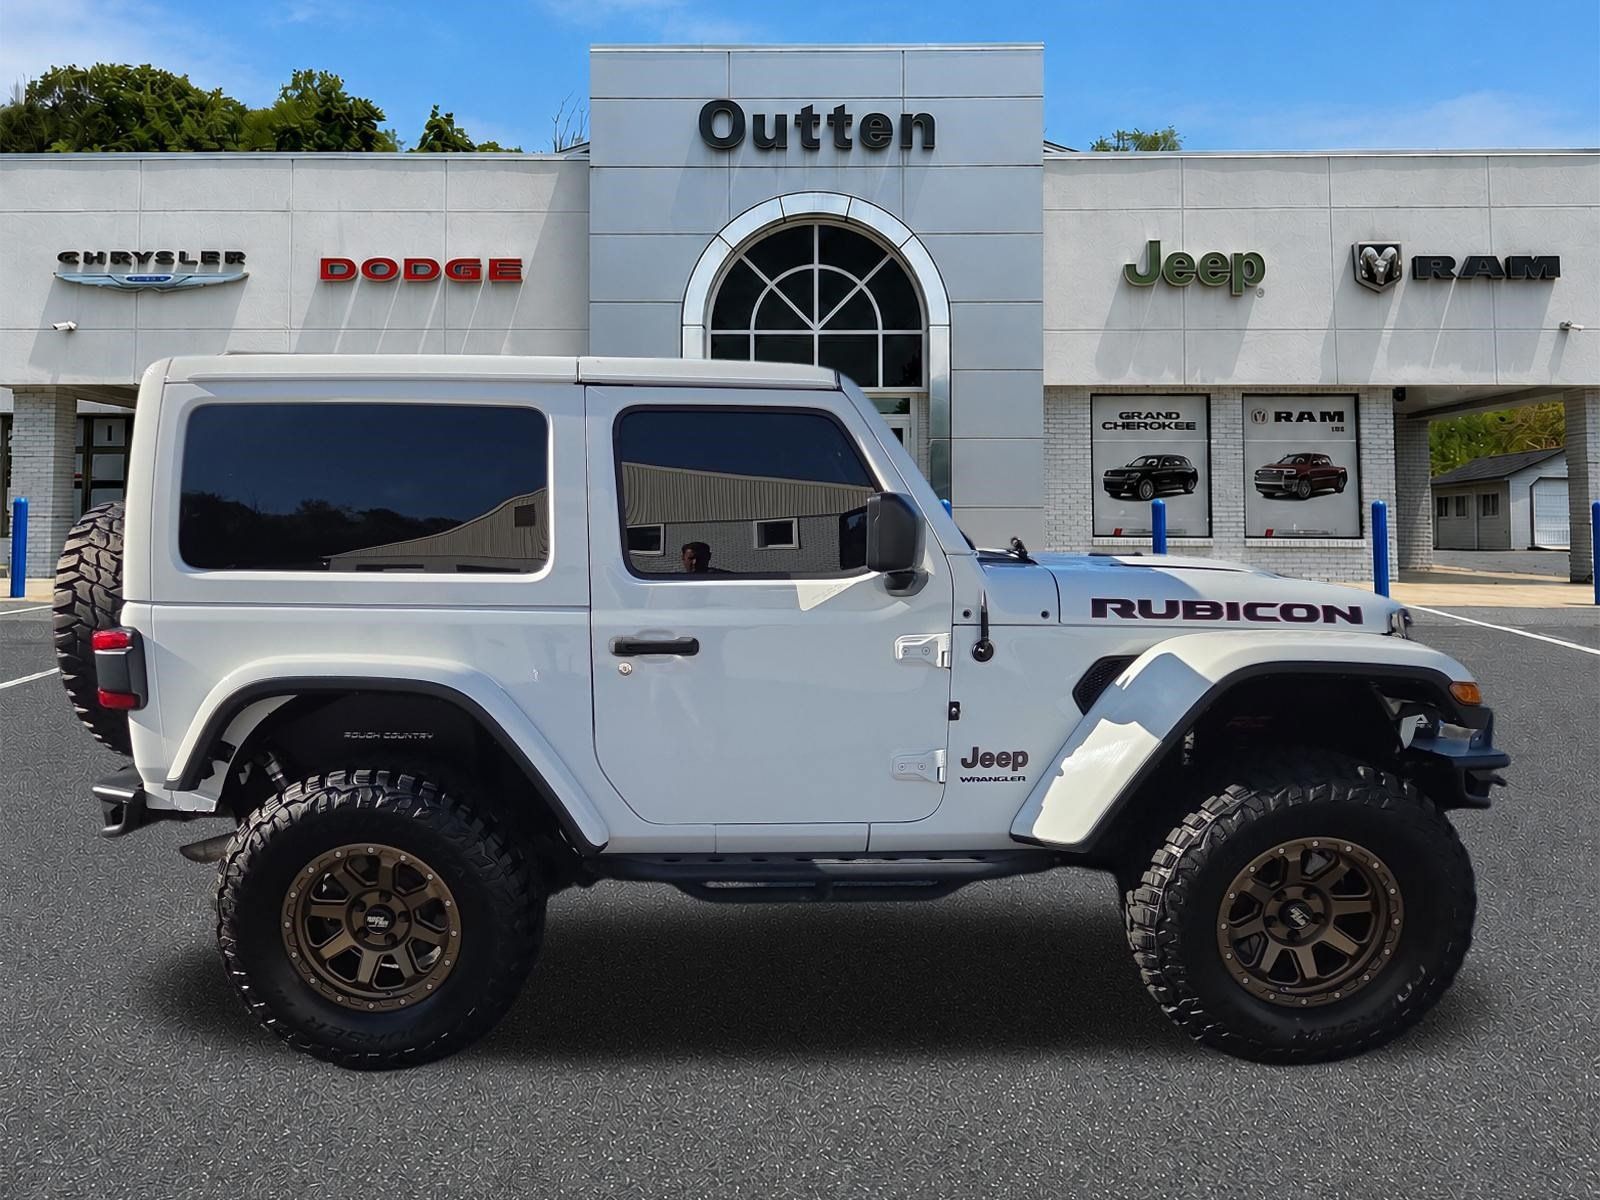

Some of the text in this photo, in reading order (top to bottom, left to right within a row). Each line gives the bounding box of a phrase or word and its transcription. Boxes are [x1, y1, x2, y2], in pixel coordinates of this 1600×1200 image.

[699, 99, 936, 151] Outten
[57, 250, 247, 267] CHRYSLER
[320, 256, 524, 283] DODGE
[1124, 239, 1266, 296] Jeep
[1411, 255, 1562, 280] RAM
[1101, 421, 1197, 431] CHEROKEE
[1118, 411, 1181, 420] GRAND
[1274, 411, 1345, 423] RAM
[1091, 598, 1363, 625] RUBICON
[960, 746, 1029, 772] Jeep
